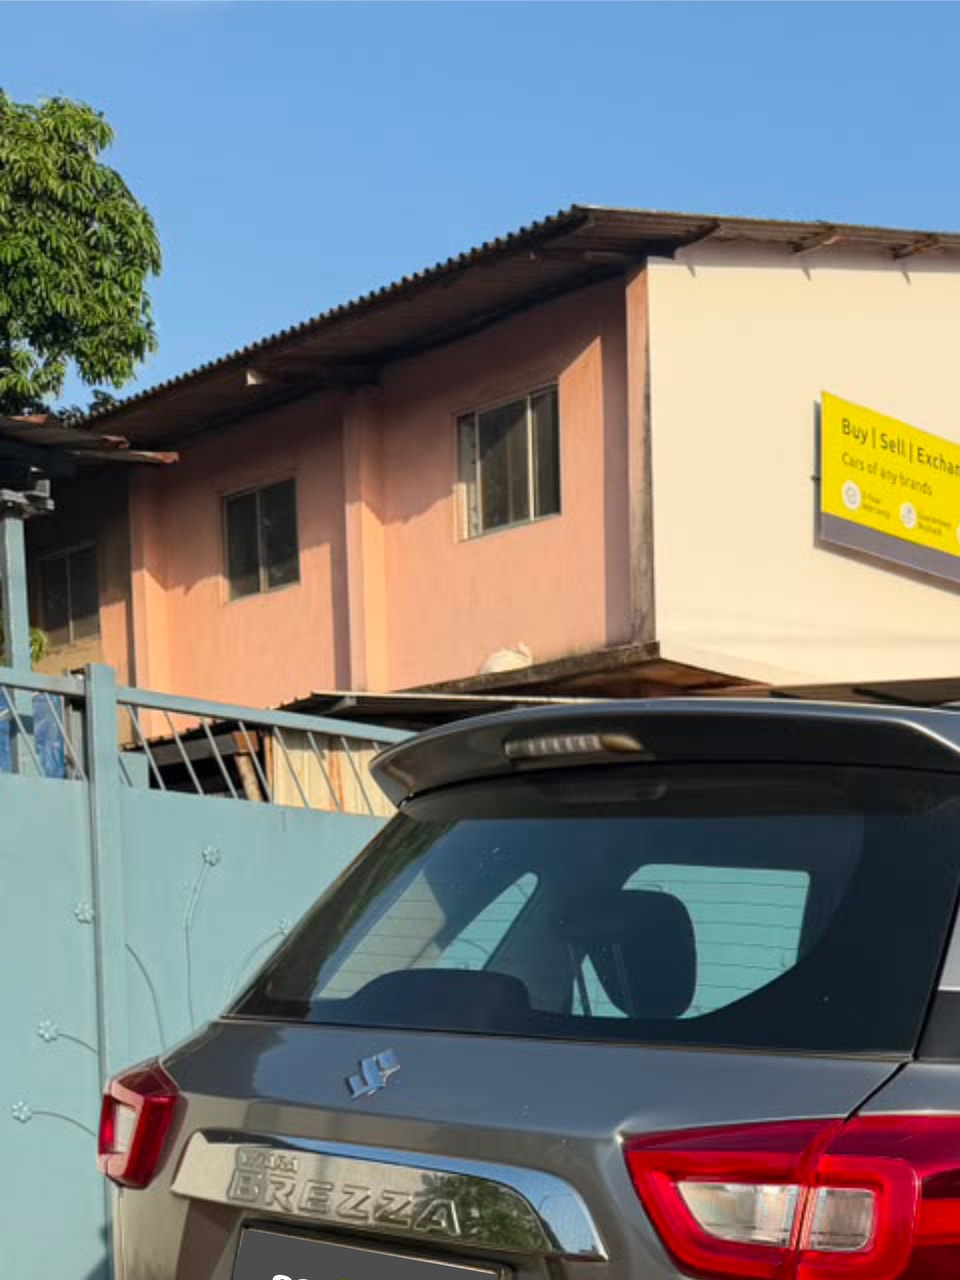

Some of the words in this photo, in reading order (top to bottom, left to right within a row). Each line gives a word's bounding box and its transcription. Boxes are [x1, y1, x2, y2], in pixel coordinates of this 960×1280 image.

[841, 417, 868, 445] Buy
[880, 433, 906, 457] Sell
[841, 452, 864, 471] Cars
[867, 461, 878, 475] of
[880, 468, 898, 485] any
[899, 471, 933, 496] brands
[227, 1166, 461, 1236] BREZZA
